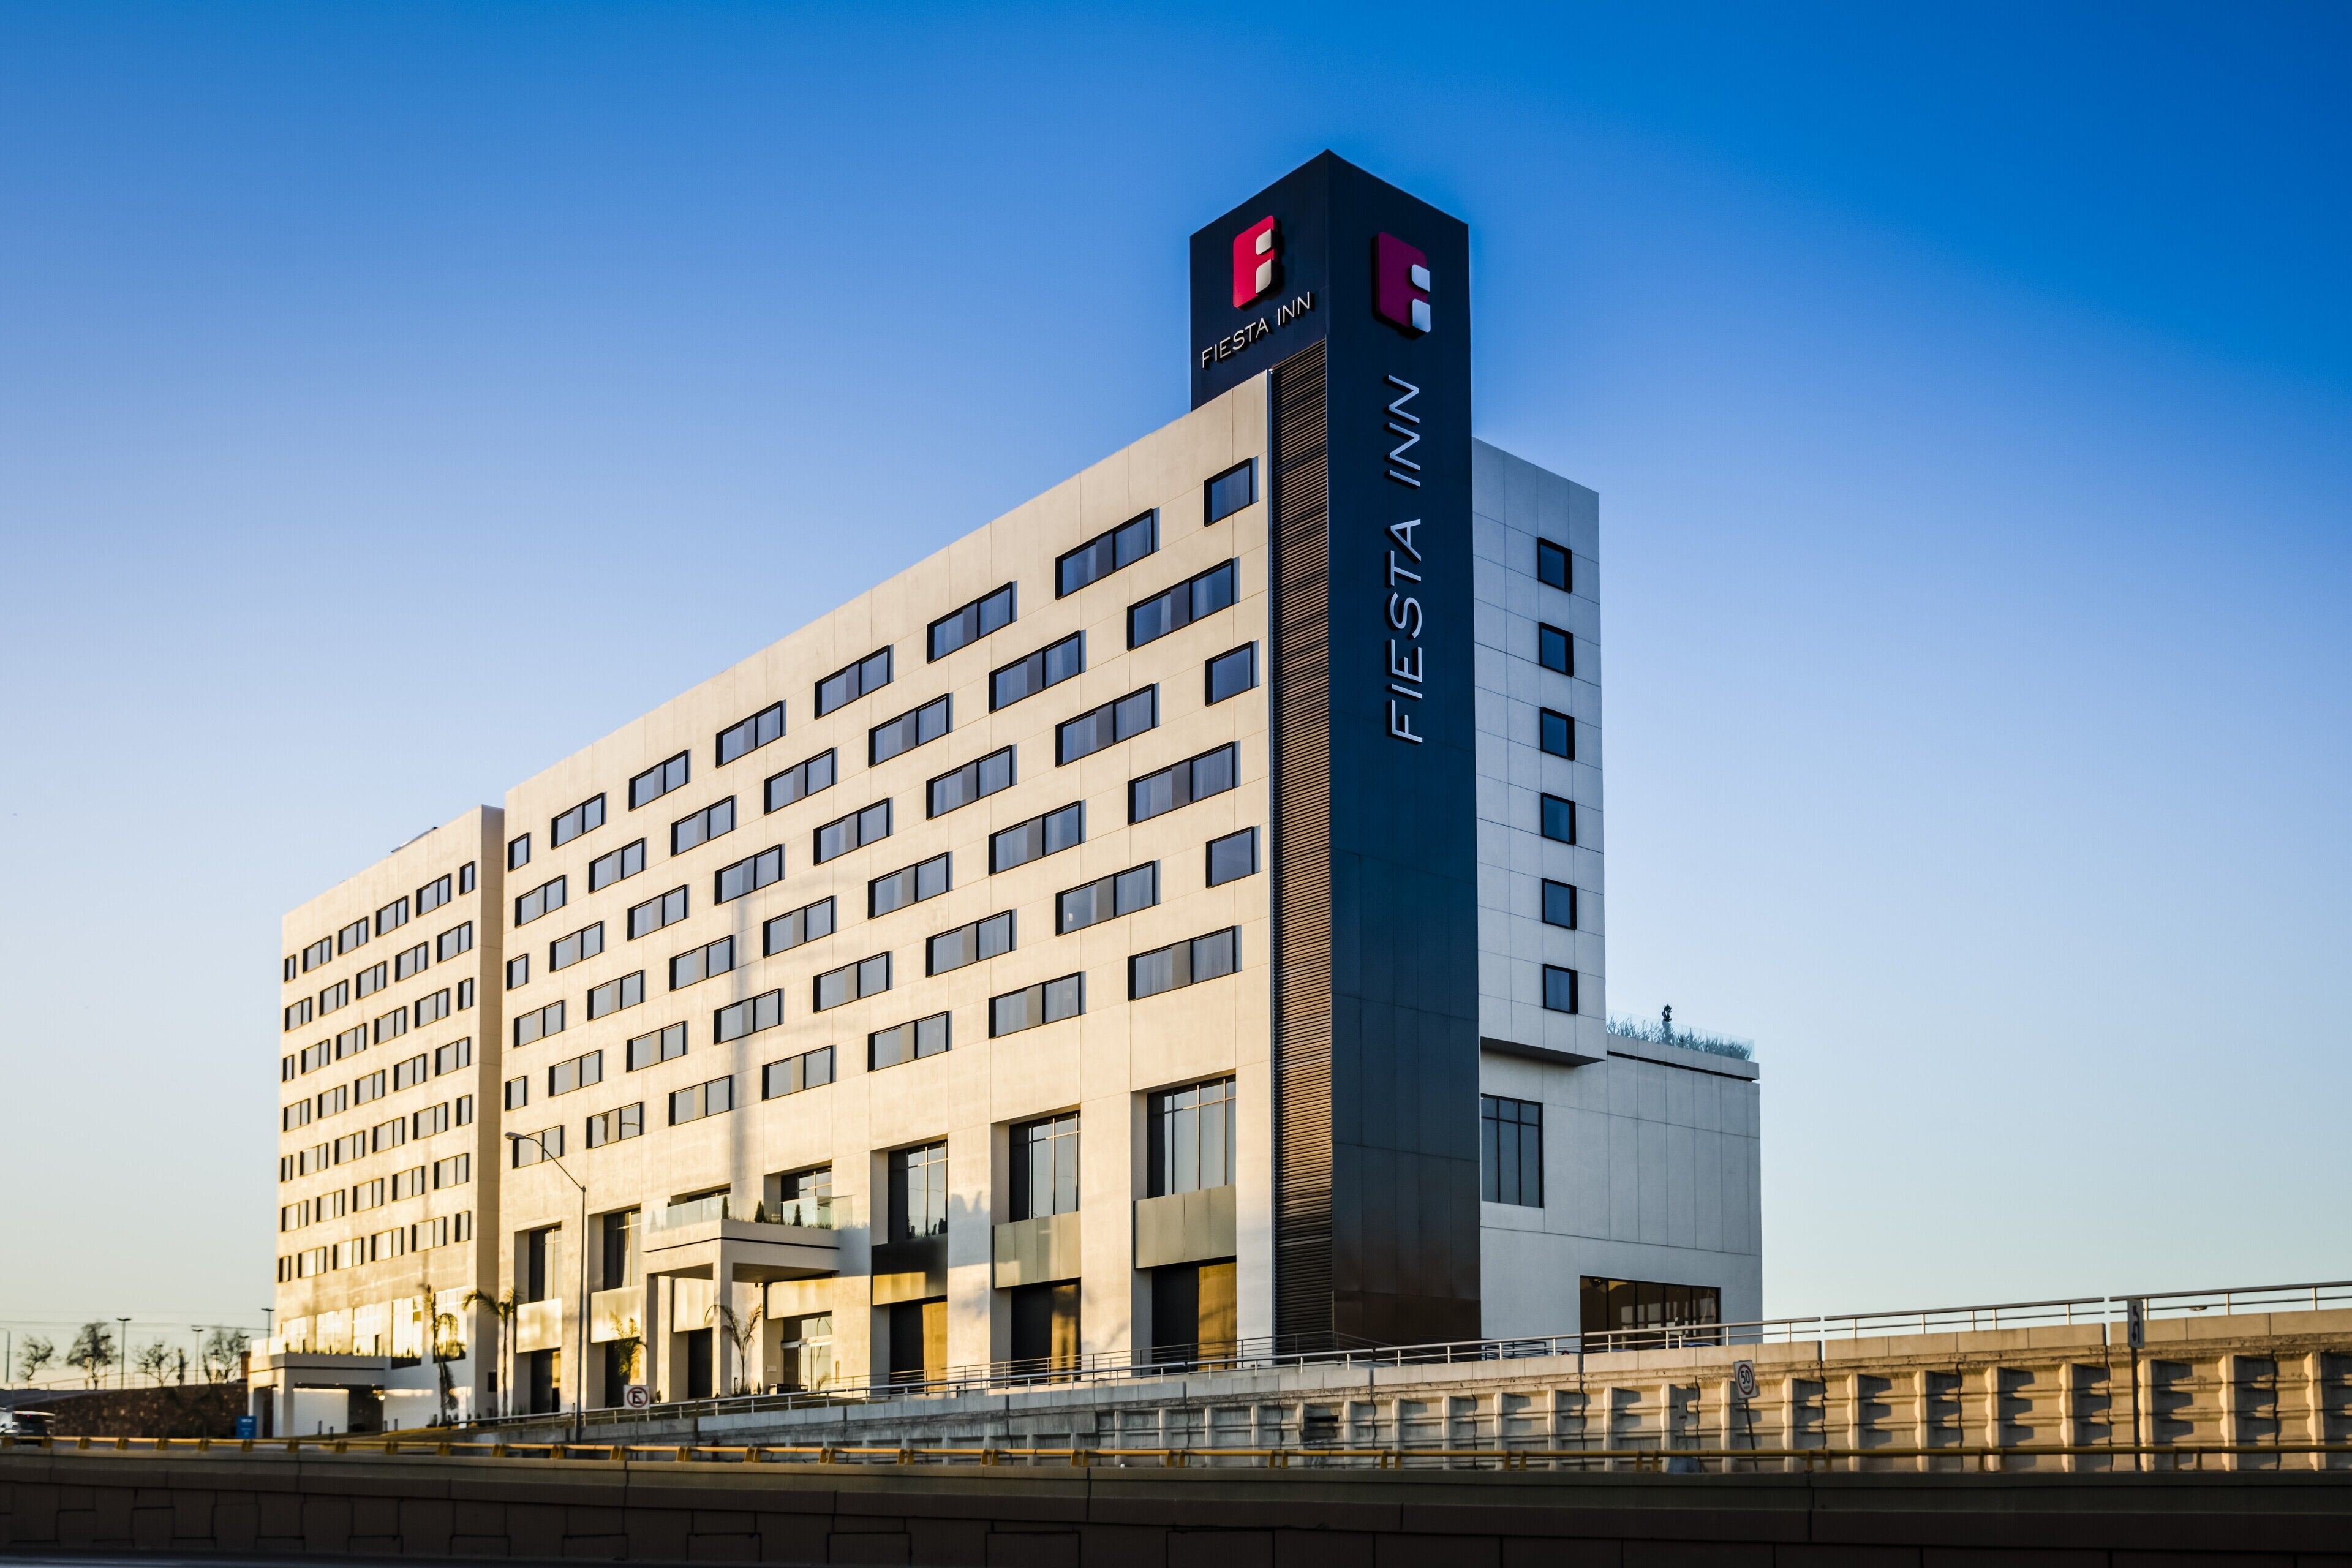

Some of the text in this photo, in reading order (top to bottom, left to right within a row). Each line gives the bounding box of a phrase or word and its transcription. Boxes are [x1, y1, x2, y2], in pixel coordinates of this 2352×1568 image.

[1201, 290, 1311, 369] FIESTA INN
[1387, 374, 1423, 744] FIESTA INN
[1740, 1370, 1751, 1384] 50
